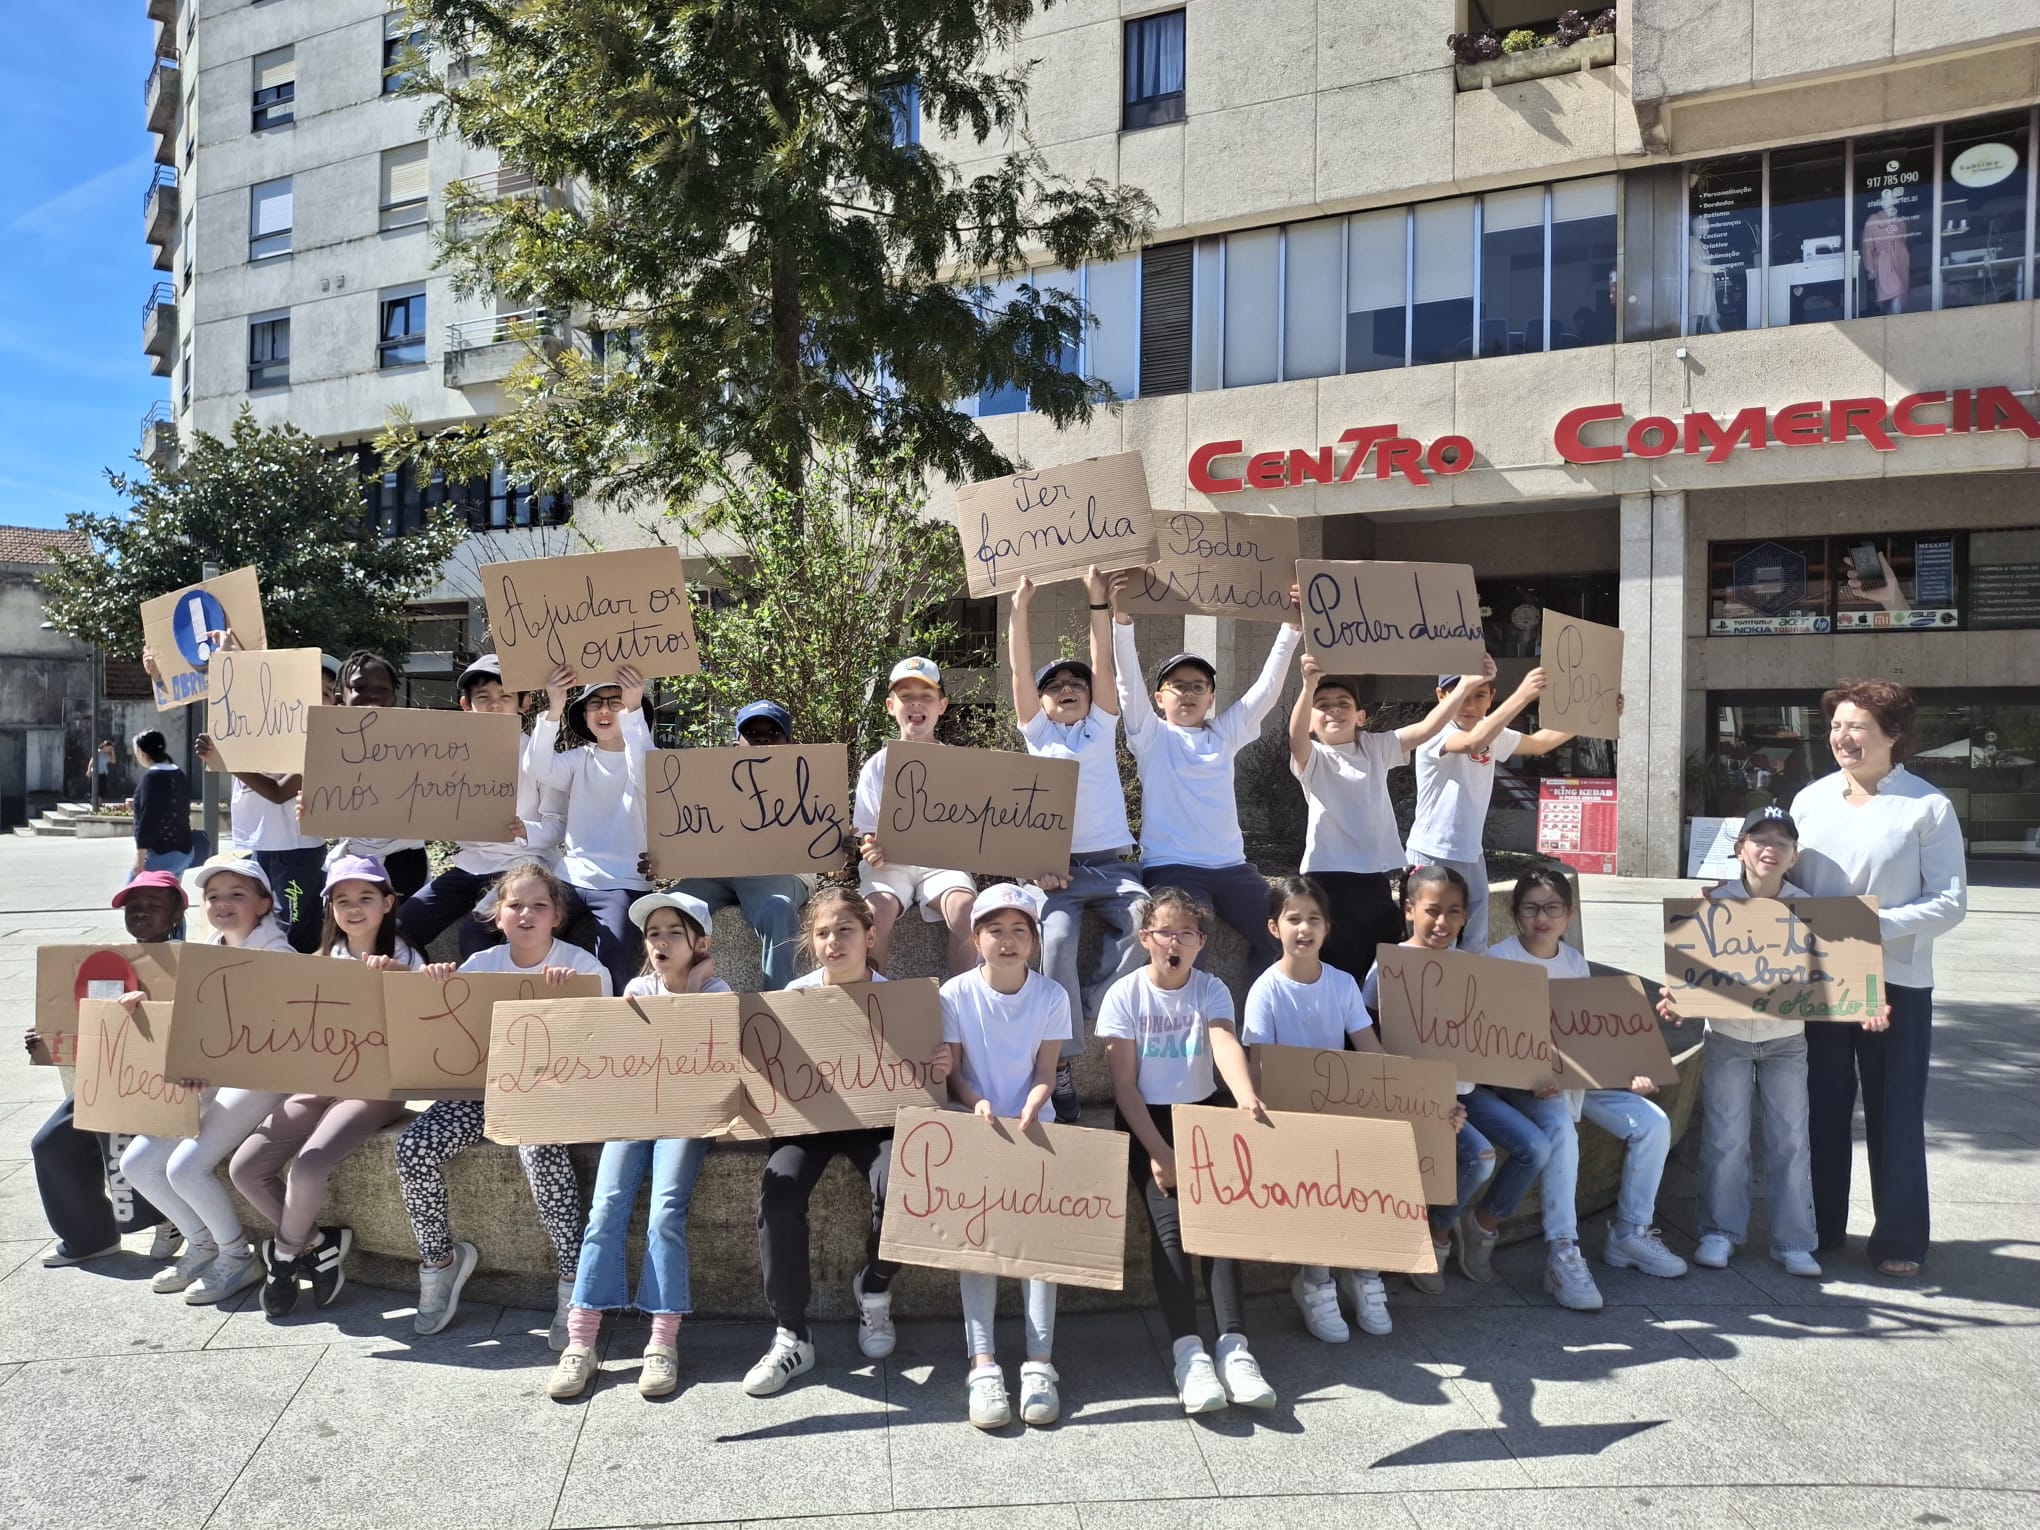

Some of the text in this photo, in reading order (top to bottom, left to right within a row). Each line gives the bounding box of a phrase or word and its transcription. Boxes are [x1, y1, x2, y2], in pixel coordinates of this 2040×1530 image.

[1866, 171, 1919, 188] 917 785 090
[1013, 473, 1072, 512] Ter
[1188, 423, 1475, 494] CENTRO
[974, 495, 1137, 586] família
[1169, 513, 1274, 562] Poder
[499, 575, 681, 666] Ajudar os
[581, 620, 690, 669] outros
[1308, 573, 1404, 648] Poder
[1734, 626, 1772, 634] NOKIA
[211, 656, 307, 741] Ser livr
[1554, 624, 1615, 725] Paz
[336, 711, 472, 764] Sermos
[311, 769, 516, 825] nós próprios
[656, 754, 845, 859] Ser Feliz
[892, 759, 1068, 854] Respeitar
[197, 960, 388, 1083] Tristeza
[1382, 960, 1552, 1062] Violência
[1551, 1005, 1653, 1074] uerra
[901, 1121, 1124, 1247] Prejudicar
[1190, 1124, 1429, 1223] Abandonar
